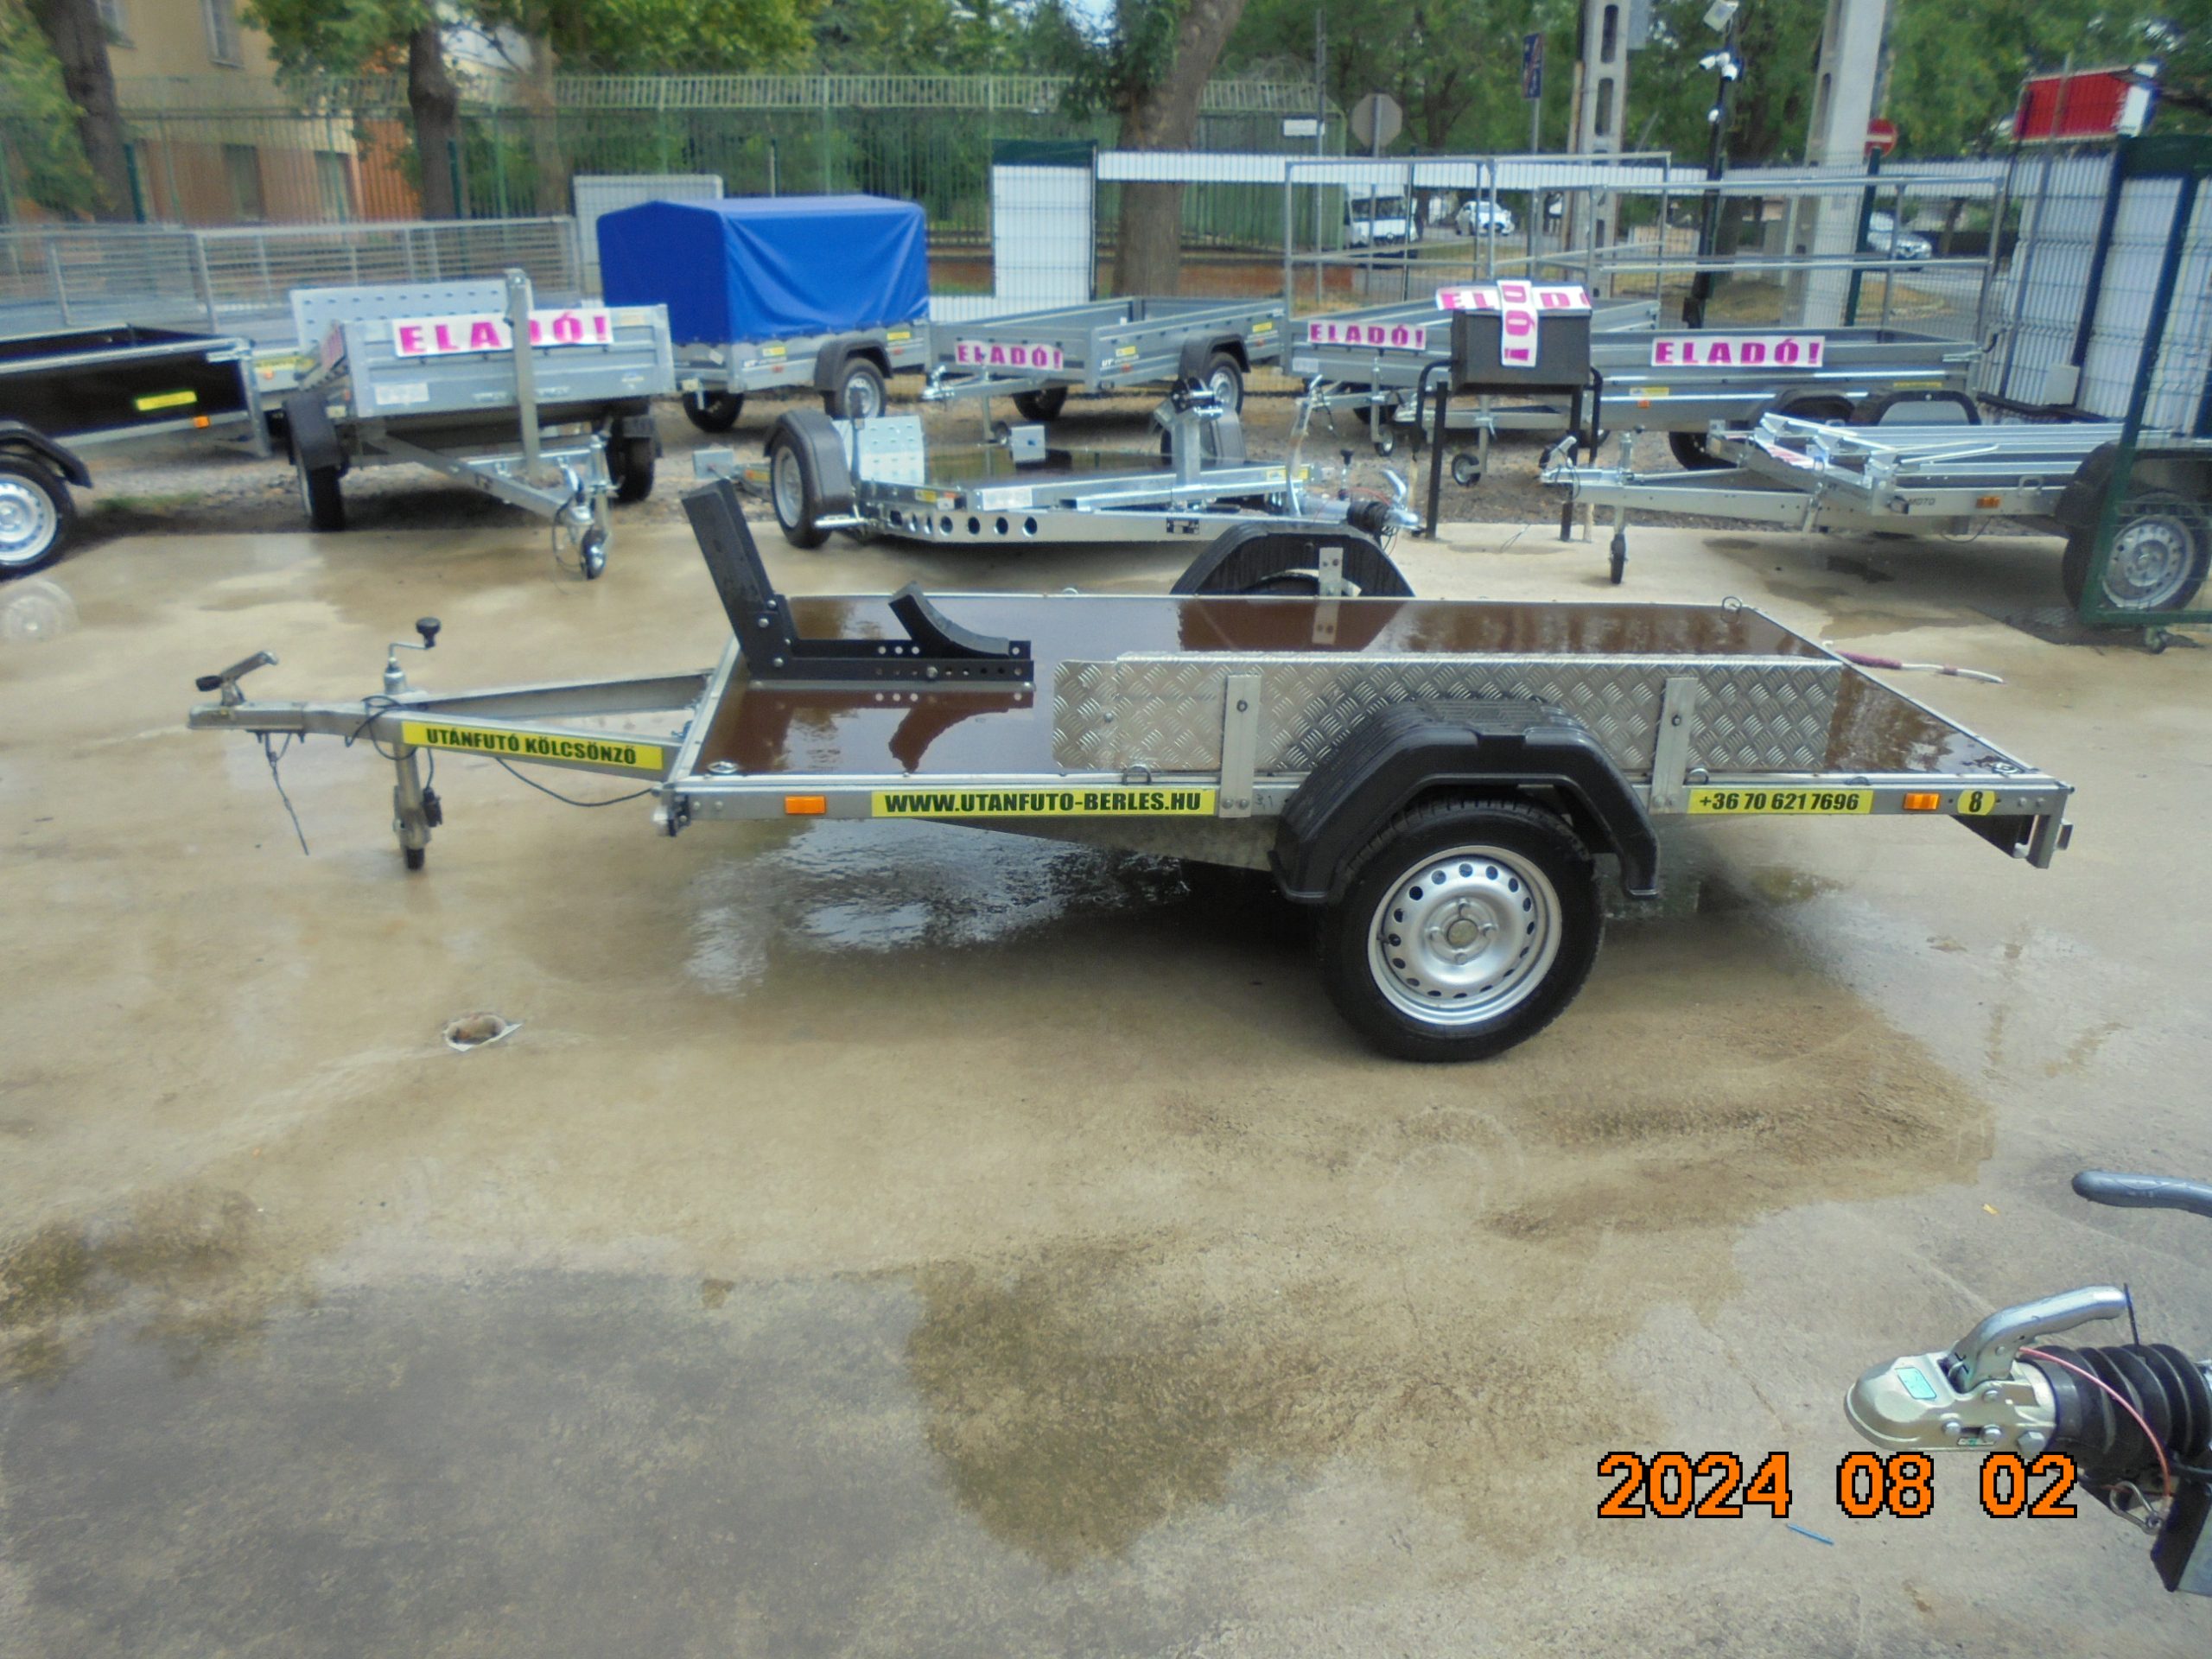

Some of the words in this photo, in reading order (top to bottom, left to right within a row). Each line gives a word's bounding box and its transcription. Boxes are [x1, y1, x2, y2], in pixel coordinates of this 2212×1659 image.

[1310, 323, 1424, 348] ELADÓ!
[957, 345, 1061, 370] ELADÓ!
[1655, 338, 1821, 365] ELADÓ!
[426, 728, 520, 752] UTÁNFUTÓ
[885, 791, 1201, 813] WWW.UTANFUTO-BERLES.HU
[1700, 792, 1739, 810] +36
[1744, 792, 1767, 810] 70
[1771, 792, 1806, 810] 621
[1811, 792, 1859, 810] 7696
[1968, 791, 1984, 813] 8
